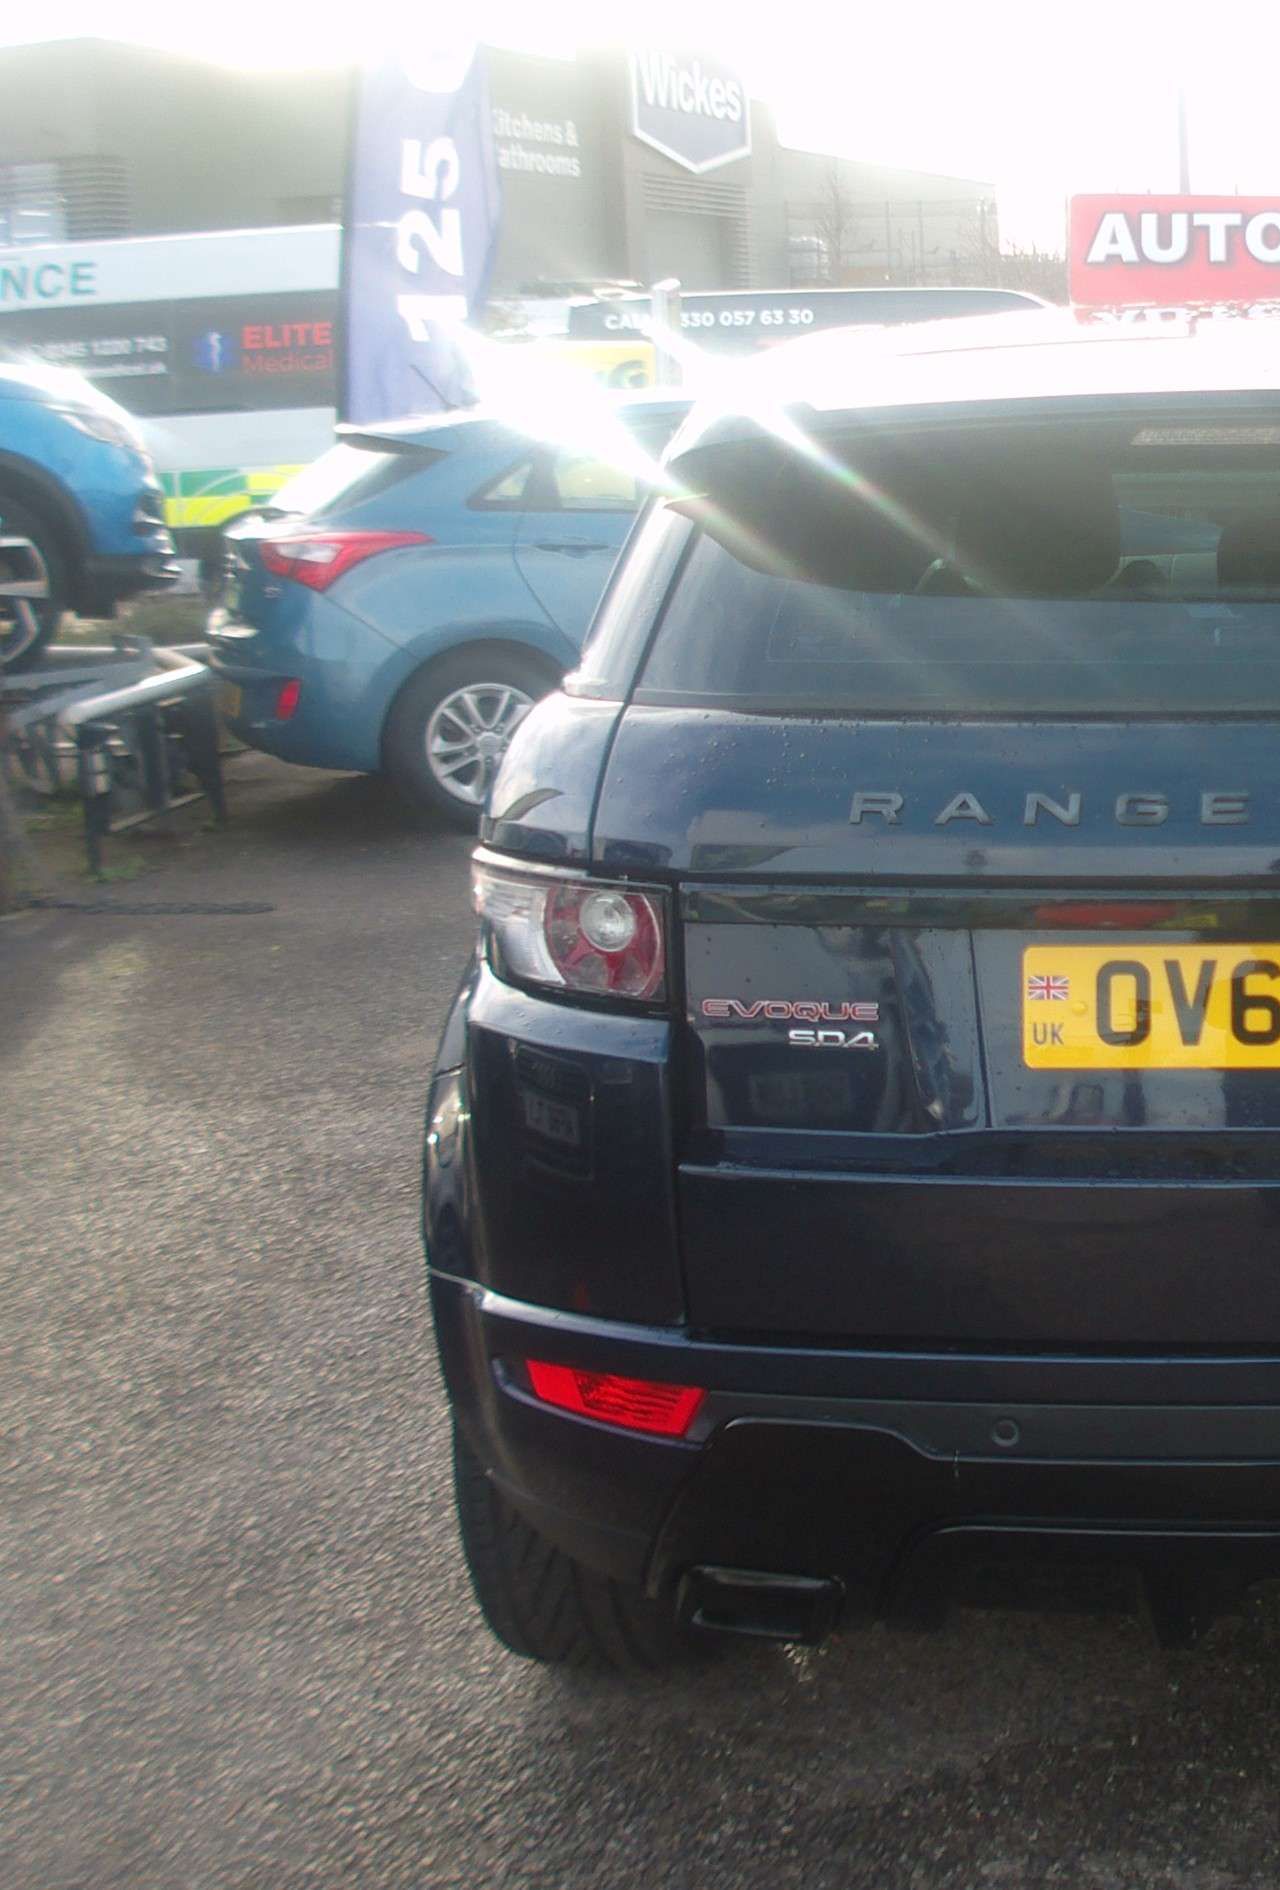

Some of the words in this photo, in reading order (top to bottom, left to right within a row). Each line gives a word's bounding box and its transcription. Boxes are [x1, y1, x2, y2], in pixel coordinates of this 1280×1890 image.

[639, 51, 743, 123] Wickes
[491, 108, 563, 144] itchens
[498, 143, 582, 177] athrooms
[397, 136, 468, 342] 125
[680, 312, 714, 329] 330
[719, 311, 756, 327] 057
[760, 309, 784, 326] 63
[788, 309, 814, 325] 30
[241, 322, 333, 350] ELITE
[242, 352, 332, 374] Medical
[849, 791, 1252, 826] RANGE
[702, 998, 880, 1023] EVOQUE
[788, 1029, 880, 1049] SD4
[1032, 1022, 1065, 1046] UK
